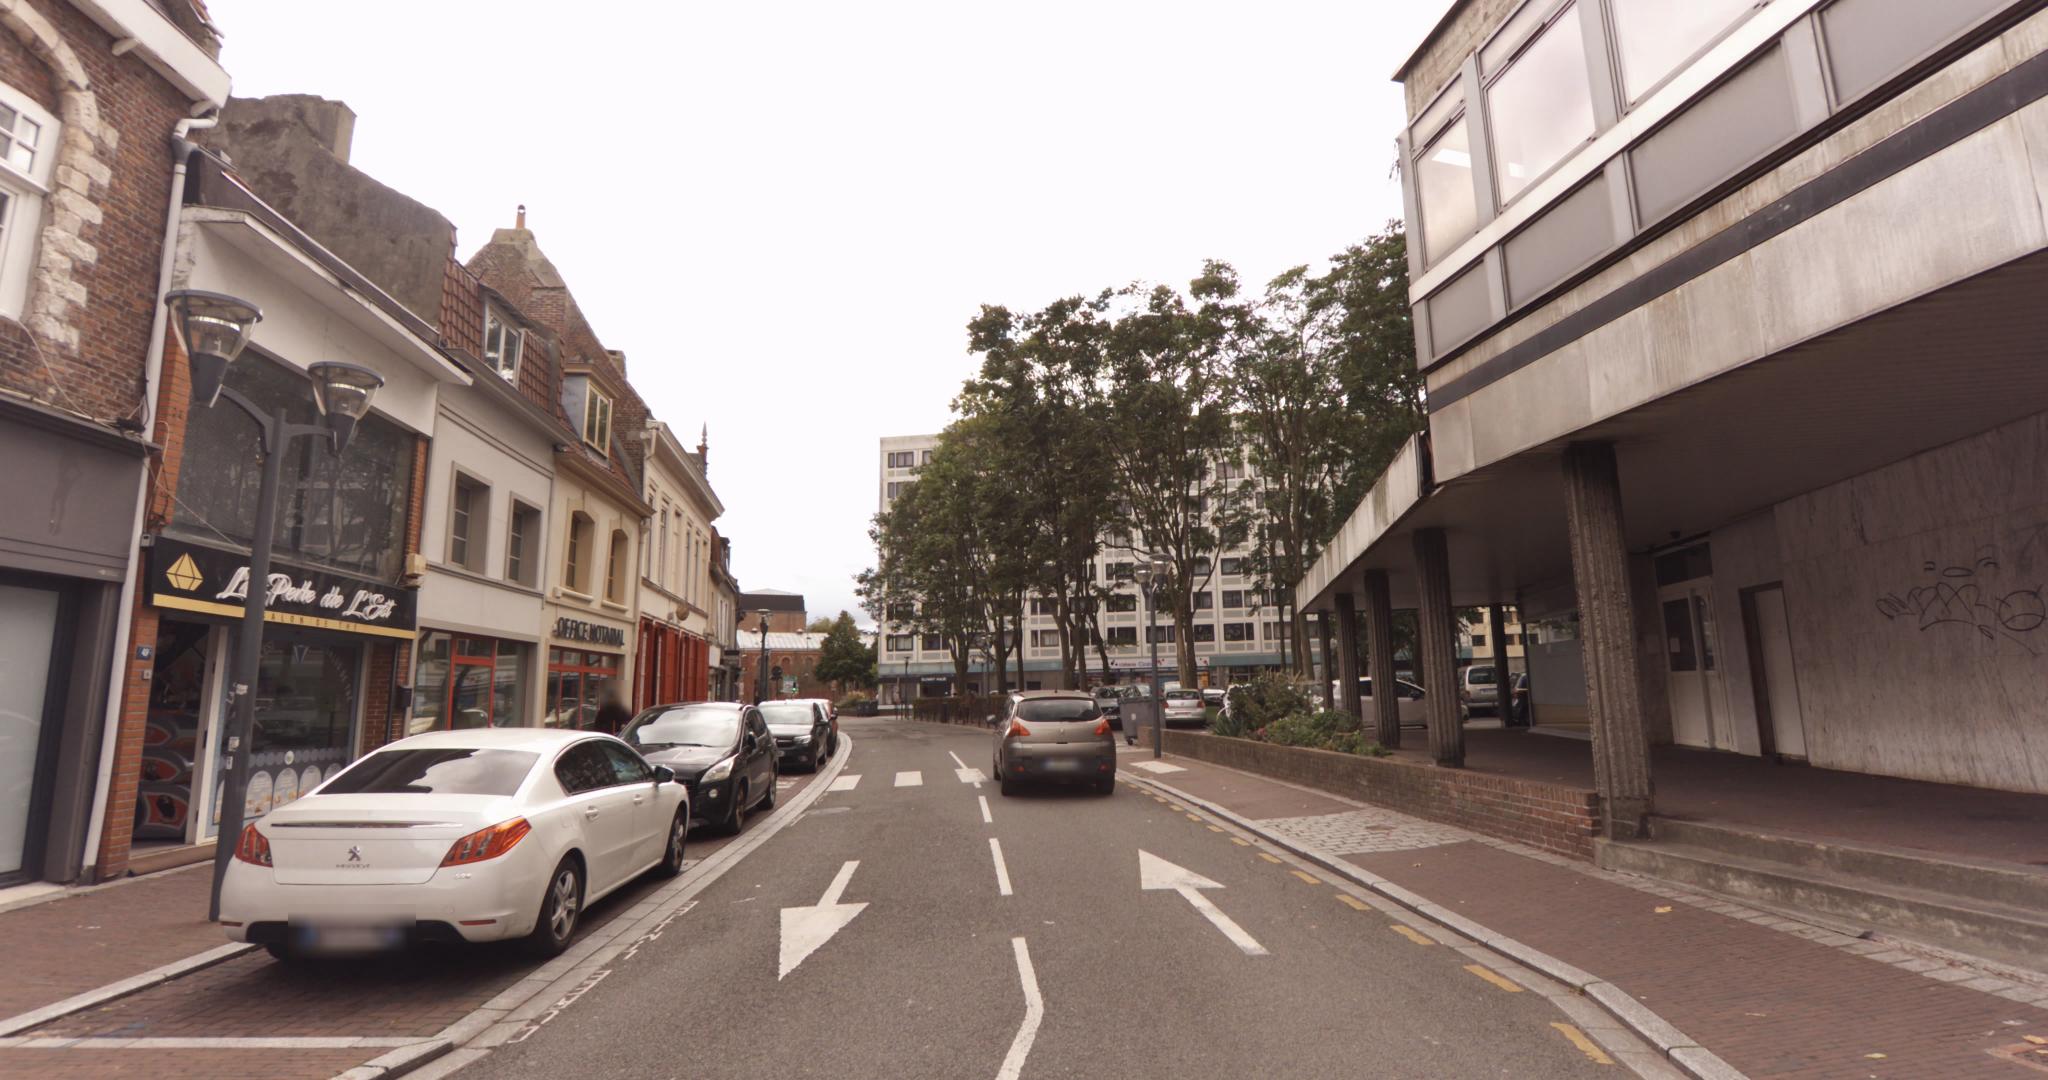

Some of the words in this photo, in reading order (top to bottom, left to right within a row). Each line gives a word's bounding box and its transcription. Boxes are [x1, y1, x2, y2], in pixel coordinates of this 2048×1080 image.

[265, 572, 317, 606] Perle
[320, 586, 344, 609] de
[557, 616, 590, 642] OFFICE
